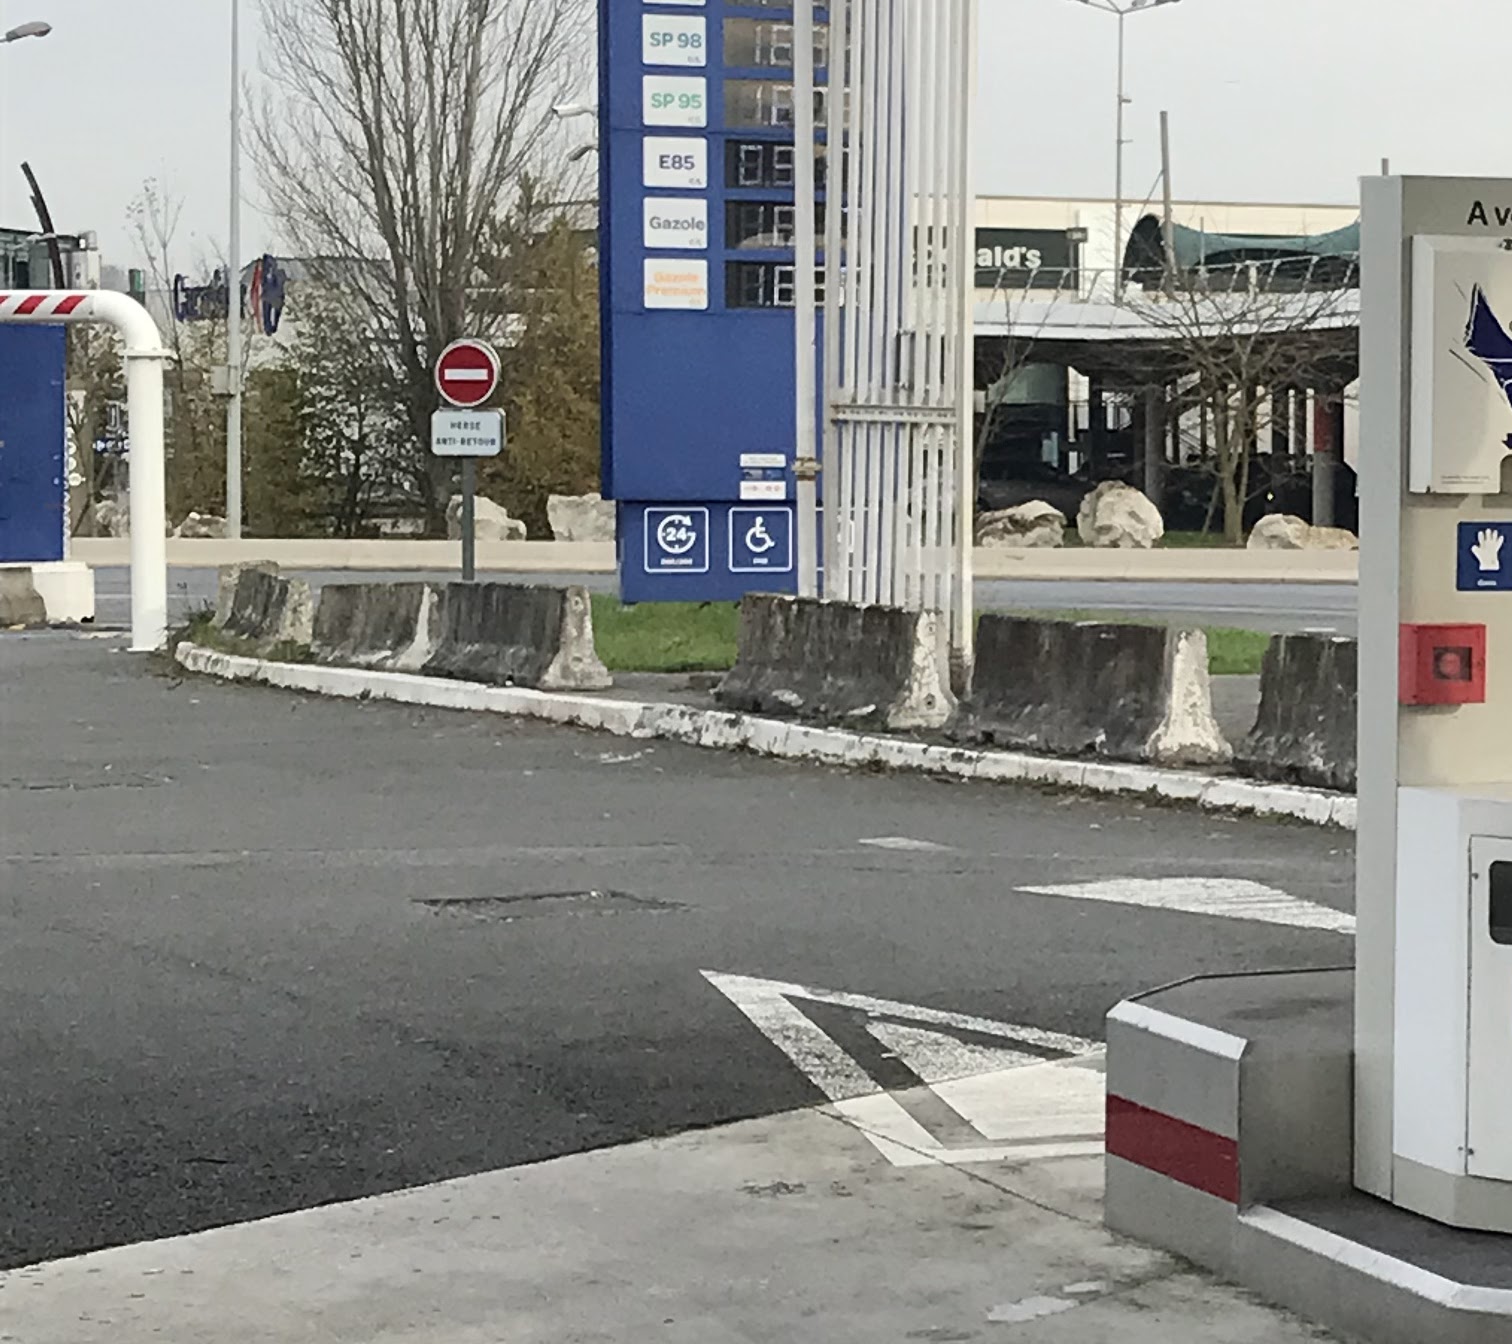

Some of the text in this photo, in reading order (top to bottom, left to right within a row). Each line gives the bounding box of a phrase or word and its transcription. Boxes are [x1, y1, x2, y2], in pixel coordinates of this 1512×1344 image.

[650, 32, 702, 49] SP 98
[651, 93, 702, 109] SP 95
[658, 154, 695, 171] E85
[1467, 200, 1488, 226] A
[649, 216, 705, 231] Gazole
